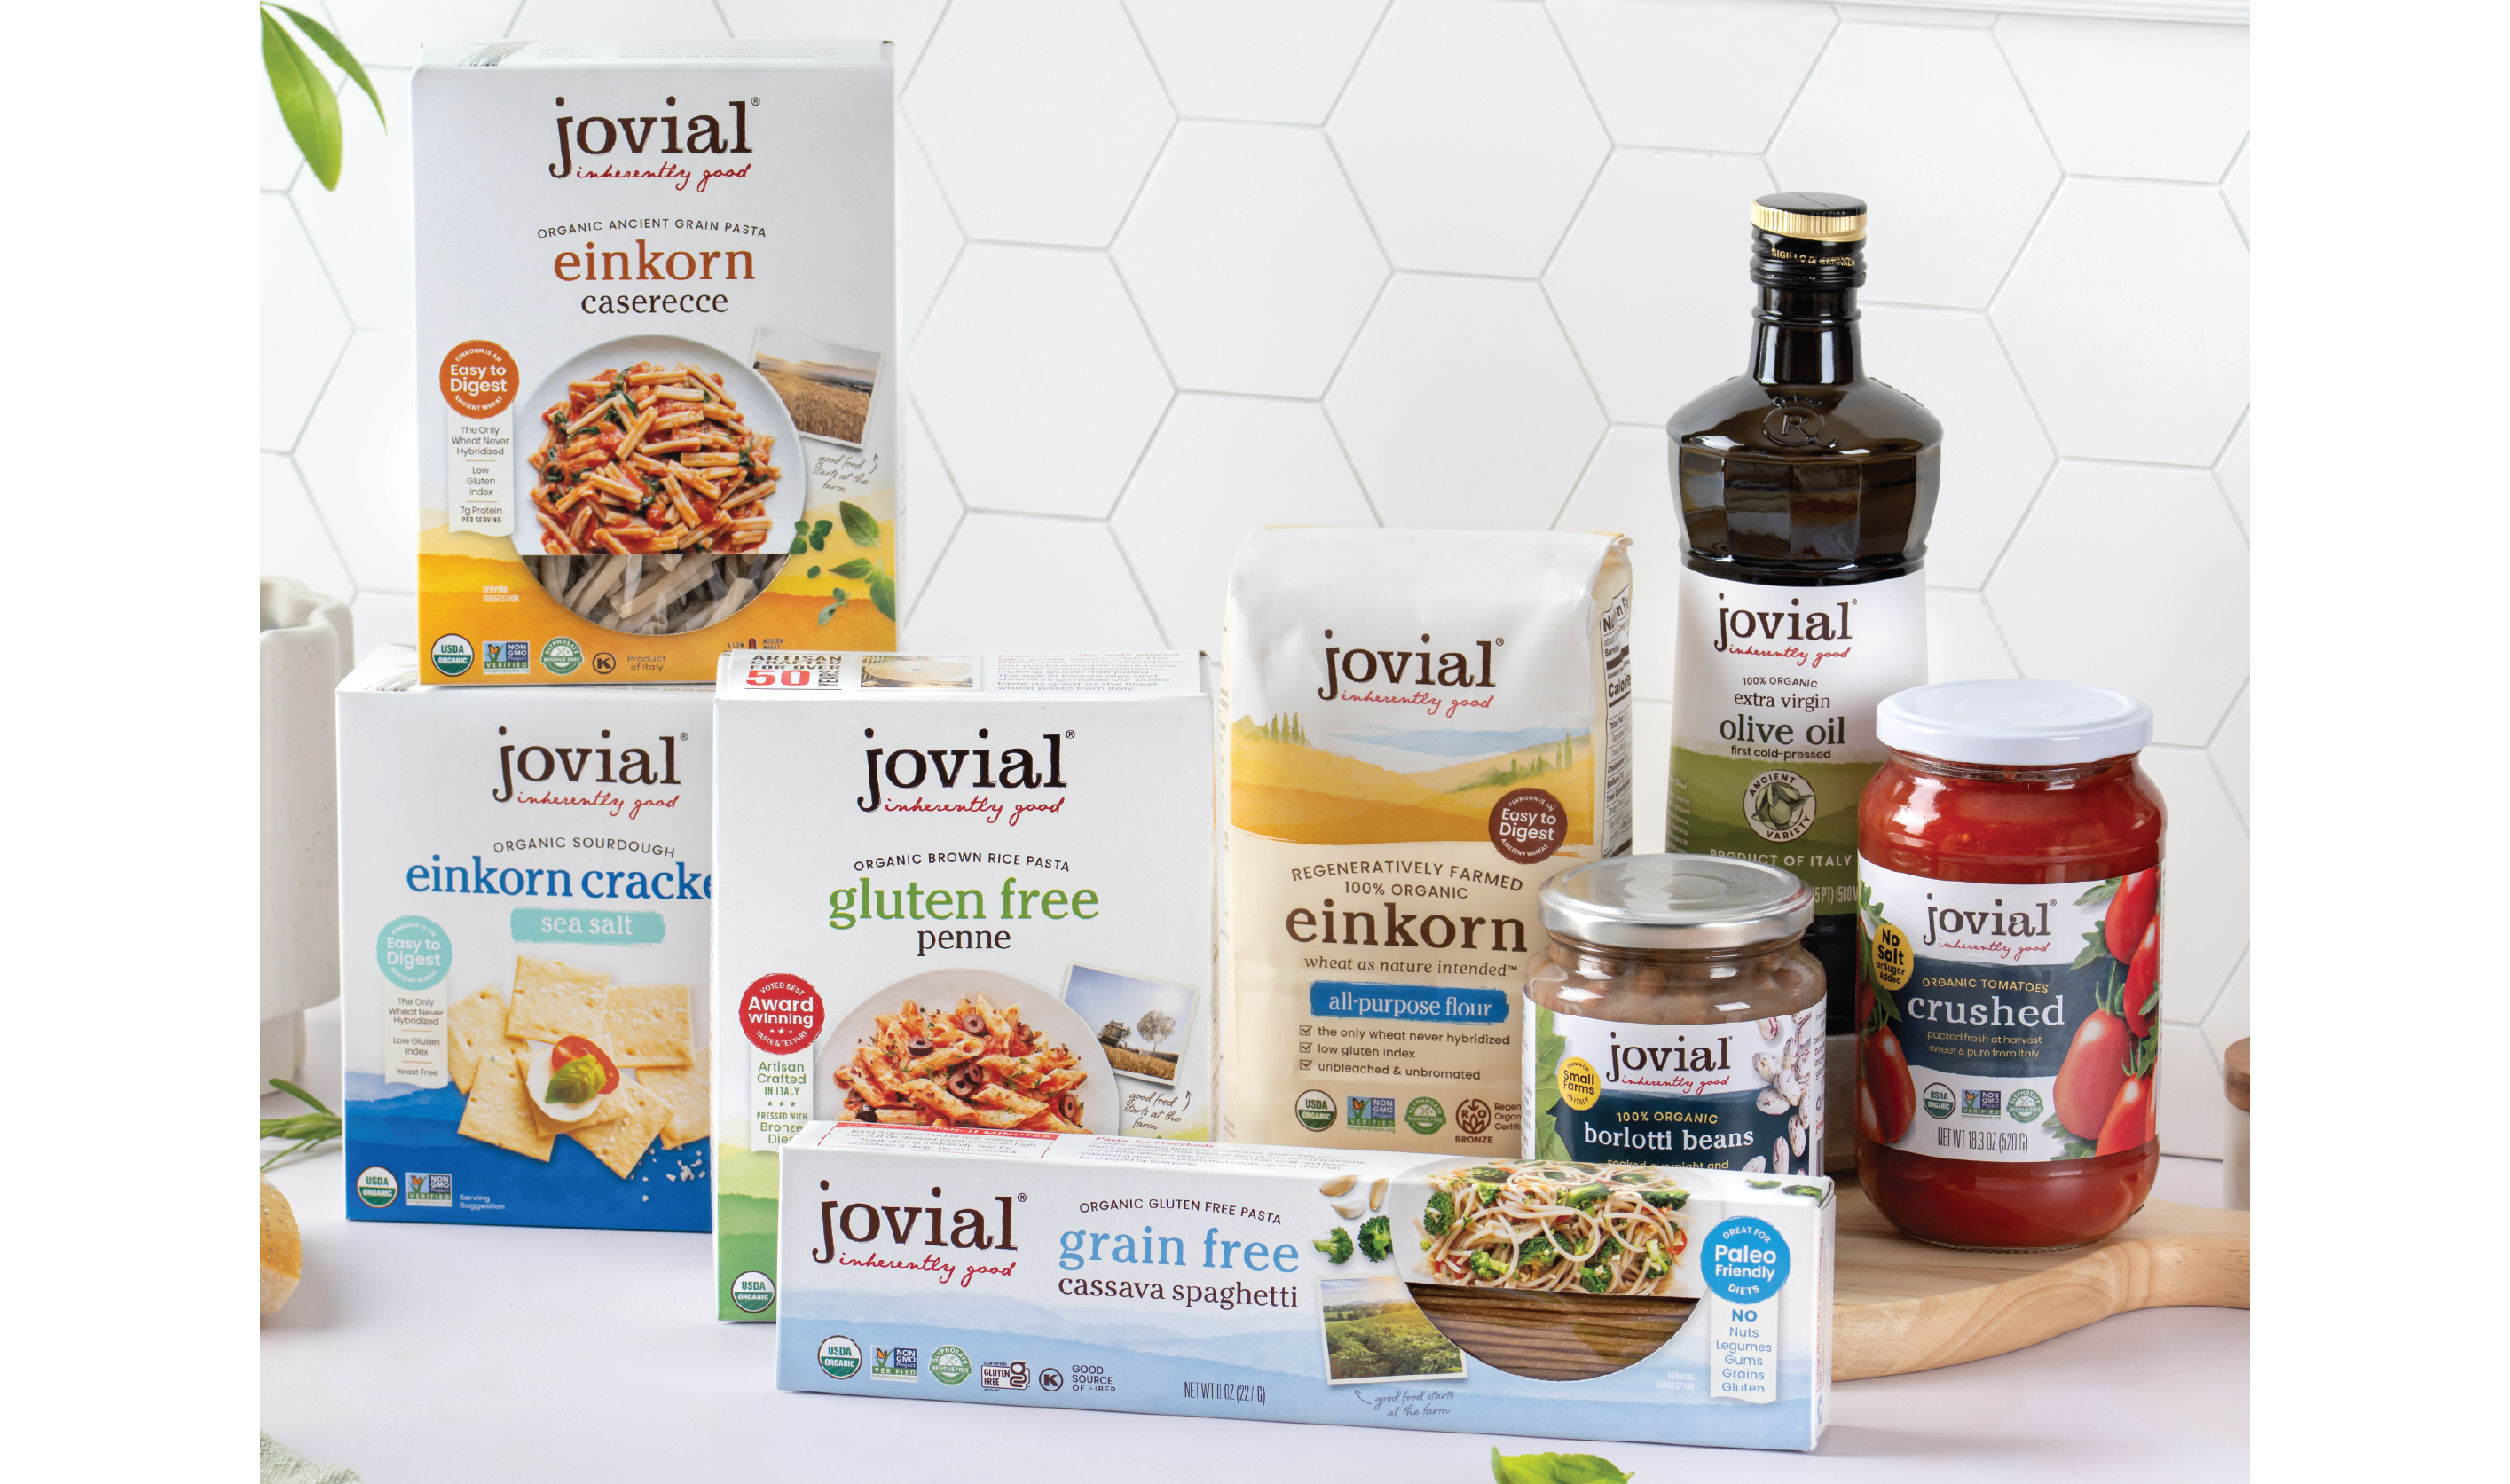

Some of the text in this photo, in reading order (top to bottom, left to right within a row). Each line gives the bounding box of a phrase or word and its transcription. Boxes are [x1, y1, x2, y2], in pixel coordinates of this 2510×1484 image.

[577, 161, 751, 192] inherently good
[537, 218, 767, 239] ORGANIC ANCIENT GRAIN PASTA
[554, 239, 755, 281] einkorn
[581, 294, 728, 314] caserecce
[451, 364, 506, 380] Easy to
[451, 377, 508, 397] Digest
[479, 427, 500, 436] Only
[457, 448, 504, 457] Hybridized
[441, 644, 464, 654] USDA
[1729, 645, 1851, 668] inherently good
[643, 663, 664, 671] Italy
[746, 670, 810, 686] 50
[1770, 677, 1817, 687] ORGANIC
[1342, 691, 1494, 718] inherently good
[1735, 692, 1830, 712] extra virgin
[1720, 714, 1845, 745] olive oil
[1731, 745, 1831, 761] first cold-pressed
[1750, 773, 1797, 797] ANCIENT
[518, 790, 681, 820] inherently good
[885, 796, 1065, 826] inherently good
[1502, 808, 1556, 826] Easy to
[1499, 822, 1554, 842] Digest
[1766, 814, 1811, 839] VARIETY
[494, 837, 674, 858] ORGANIC SOURDOUGH
[854, 852, 1070, 872] ORGANIC BROWN RICE PASTA
[406, 854, 573, 897] einkorn
[1292, 860, 1523, 891] REGENERATIVELY FARMED
[1345, 881, 1468, 899] 100% ORGANIC
[830, 876, 1098, 930] gluten free
[541, 915, 633, 935] sea salt
[1286, 898, 1527, 952] einkorn
[388, 937, 440, 954] Easy to
[917, 930, 1011, 956] penne
[1883, 929, 1900, 946] No
[1878, 945, 1903, 965] Salt
[1939, 939, 2050, 961] inherently good
[388, 950, 440, 970] Digest
[1884, 963, 1905, 975] Sugar
[1880, 971, 1900, 985] Added
[1922, 978, 2049, 993] ORGANIC TOMATOES
[759, 982, 805, 995] VOTED BEST
[748, 996, 814, 1011] Award
[1329, 992, 1492, 1017] all-purpose flour
[1908, 995, 2065, 1026] crushed
[748, 1013, 814, 1028] winning
[1318, 1026, 1510, 1045] the only wheat never hybridized
[1927, 1031, 1962, 1041] packed
[1964, 1033, 1988, 1042] fresh
[1929, 1045, 1956, 1055] sweet
[1967, 1048, 1990, 1057] pure
[1993, 1048, 2017, 1057] from
[2018, 1049, 2039, 1059] Italy
[759, 1062, 804, 1072] Artisan
[758, 1073, 806, 1084] Crafted
[1564, 1070, 1594, 1085] Small
[1622, 1076, 1729, 1095] inherently good
[776, 1087, 799, 1095] ITALY
[1563, 1080, 1594, 1095] Farms
[1617, 1111, 1719, 1124] 100% ORGANIC
[1585, 1122, 1754, 1150] borlotti beans
[1938, 1127, 2028, 1153] NET WT 18.3 OZ (520 G)
[460, 1202, 505, 1211] Suggestion
[1080, 1197, 1282, 1224] ORGANIC GLUTEN FREE PASTA
[1723, 1227, 1771, 1243] GREAT FOR
[1058, 1225, 1299, 1273] grain free
[1715, 1245, 1776, 1264] Paleo
[838, 1252, 1017, 1288] inherently good
[1715, 1264, 1775, 1282] Friendly
[1058, 1277, 1298, 1310] cassava spaghetti
[1728, 1284, 1759, 1295] DIETS
[1732, 1309, 1757, 1322] NO
[1729, 1327, 1759, 1338] Nuts
[1716, 1340, 1772, 1354] Legumes
[1725, 1355, 1763, 1365] Gums
[984, 1369, 1010, 1378] GLUTEN
[1073, 1365, 1104, 1374] GOOD
[1723, 1369, 1764, 1380] Grains
[1073, 1375, 1112, 1384] SOURCE
